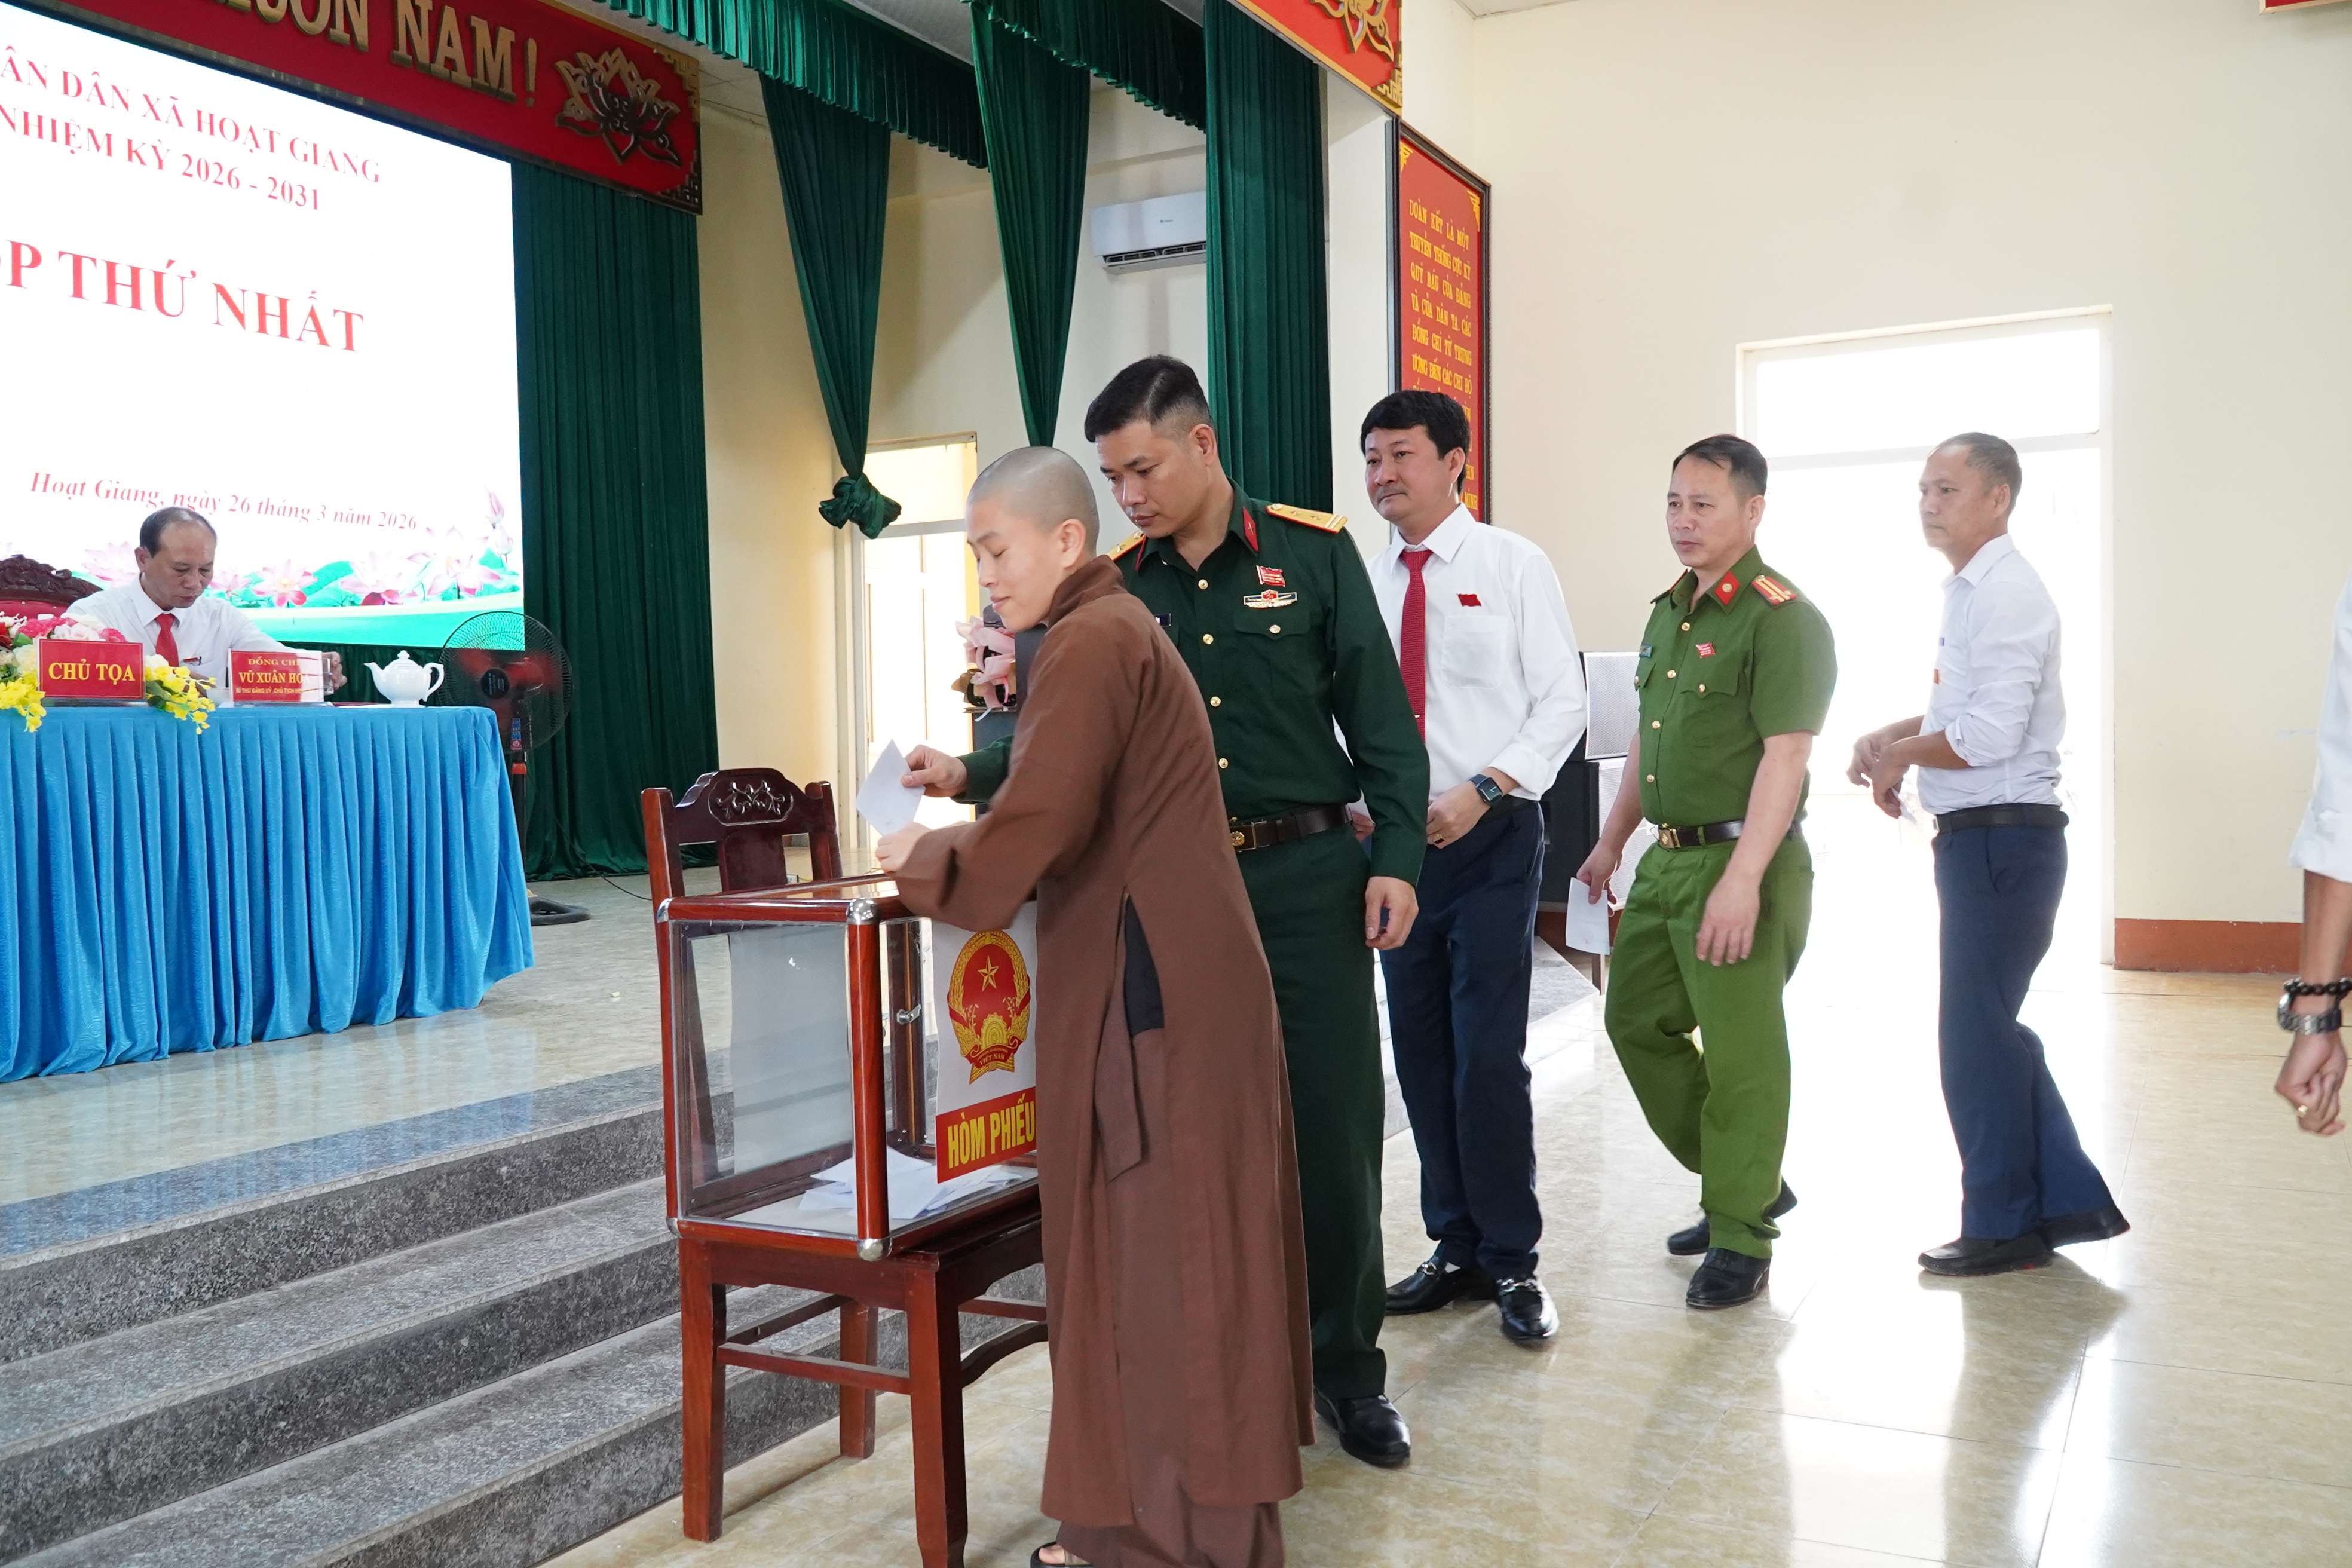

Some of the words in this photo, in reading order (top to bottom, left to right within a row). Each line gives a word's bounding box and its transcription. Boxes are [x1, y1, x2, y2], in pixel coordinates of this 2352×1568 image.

[62, 71, 129, 112] DÂN
[142, 93, 185, 128] XÃ
[196, 109, 280, 153] HOẠT
[290, 137, 379, 182] GIANG
[0, 104, 113, 157] NHIỆM
[127, 138, 171, 171] KỲ
[181, 154, 240, 189] 2026
[267, 177, 318, 210] 2031
[1446, 218, 1454, 241] LÀ
[58, 250, 197, 317] THỨ
[210, 282, 363, 353] NHẤT
[1411, 262, 1423, 284] QUÝ
[1443, 274, 1453, 300] CỦA
[1411, 288, 1420, 312] VÀ
[1422, 292, 1433, 318] CỦA
[1462, 315, 1472, 337] CÁC
[1432, 331, 1442, 353] CHÍ
[1442, 363, 1452, 386] CÁC
[1453, 373, 1463, 391] CHI
[30, 472, 86, 500] Hoạt
[95, 479, 164, 509] Giang,
[173, 490, 221, 514] ngày
[228, 495, 250, 513] 26
[258, 498, 311, 524] tháng
[317, 505, 326, 521] 3
[333, 508, 371, 525] năm
[378, 512, 416, 530] 2026
[48, 658, 91, 681] CHỦ
[96, 664, 136, 685] TỌA
[238, 670, 255, 683] VŨ
[256, 669, 286, 683] XUÂN
[947, 1112, 985, 1169] HÒM
[990, 1093, 1035, 1154] PHIẾU
